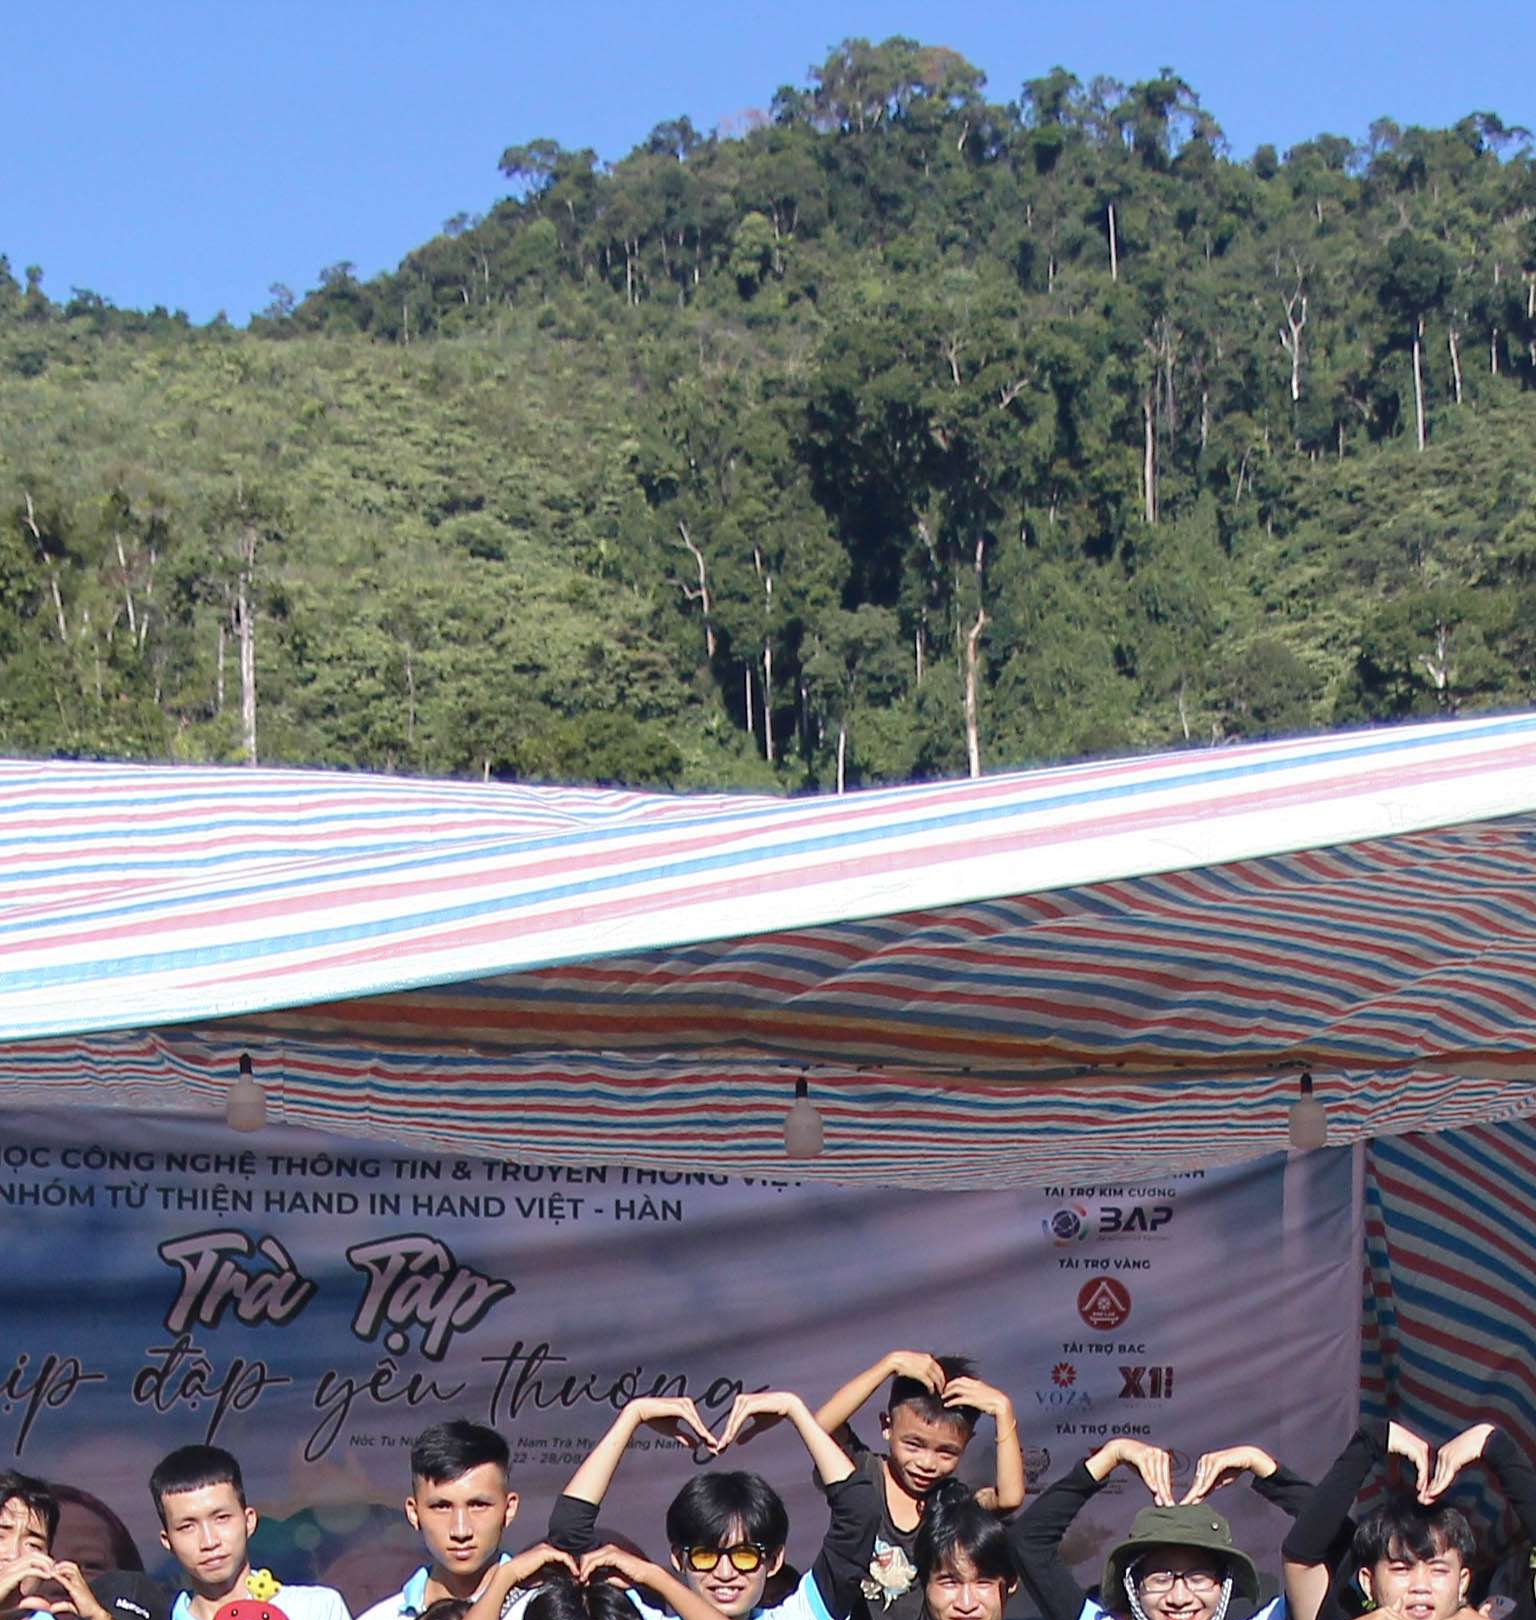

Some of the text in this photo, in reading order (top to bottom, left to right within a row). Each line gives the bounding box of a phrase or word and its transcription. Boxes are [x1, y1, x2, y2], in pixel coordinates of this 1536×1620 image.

[59, 1143, 155, 1172] CÔNG
[166, 1150, 257, 1180] NGHỆ
[267, 1152, 381, 1178] THÔNG
[391, 1158, 441, 1181] TIN
[105, 1180, 148, 1210] TỪ
[157, 1184, 253, 1218] THIỆN
[265, 1190, 359, 1215] HAND
[370, 1193, 400, 1216] IN
[413, 1195, 506, 1219] HAND
[515, 1192, 584, 1226] VIỆT
[615, 1194, 683, 1222] HÀN
[1099, 1187, 1124, 1198] KIM
[160, 1230, 517, 1363] Trà Tập
[133, 1332, 294, 1447] đập
[302, 1359, 465, 1464] yêu
